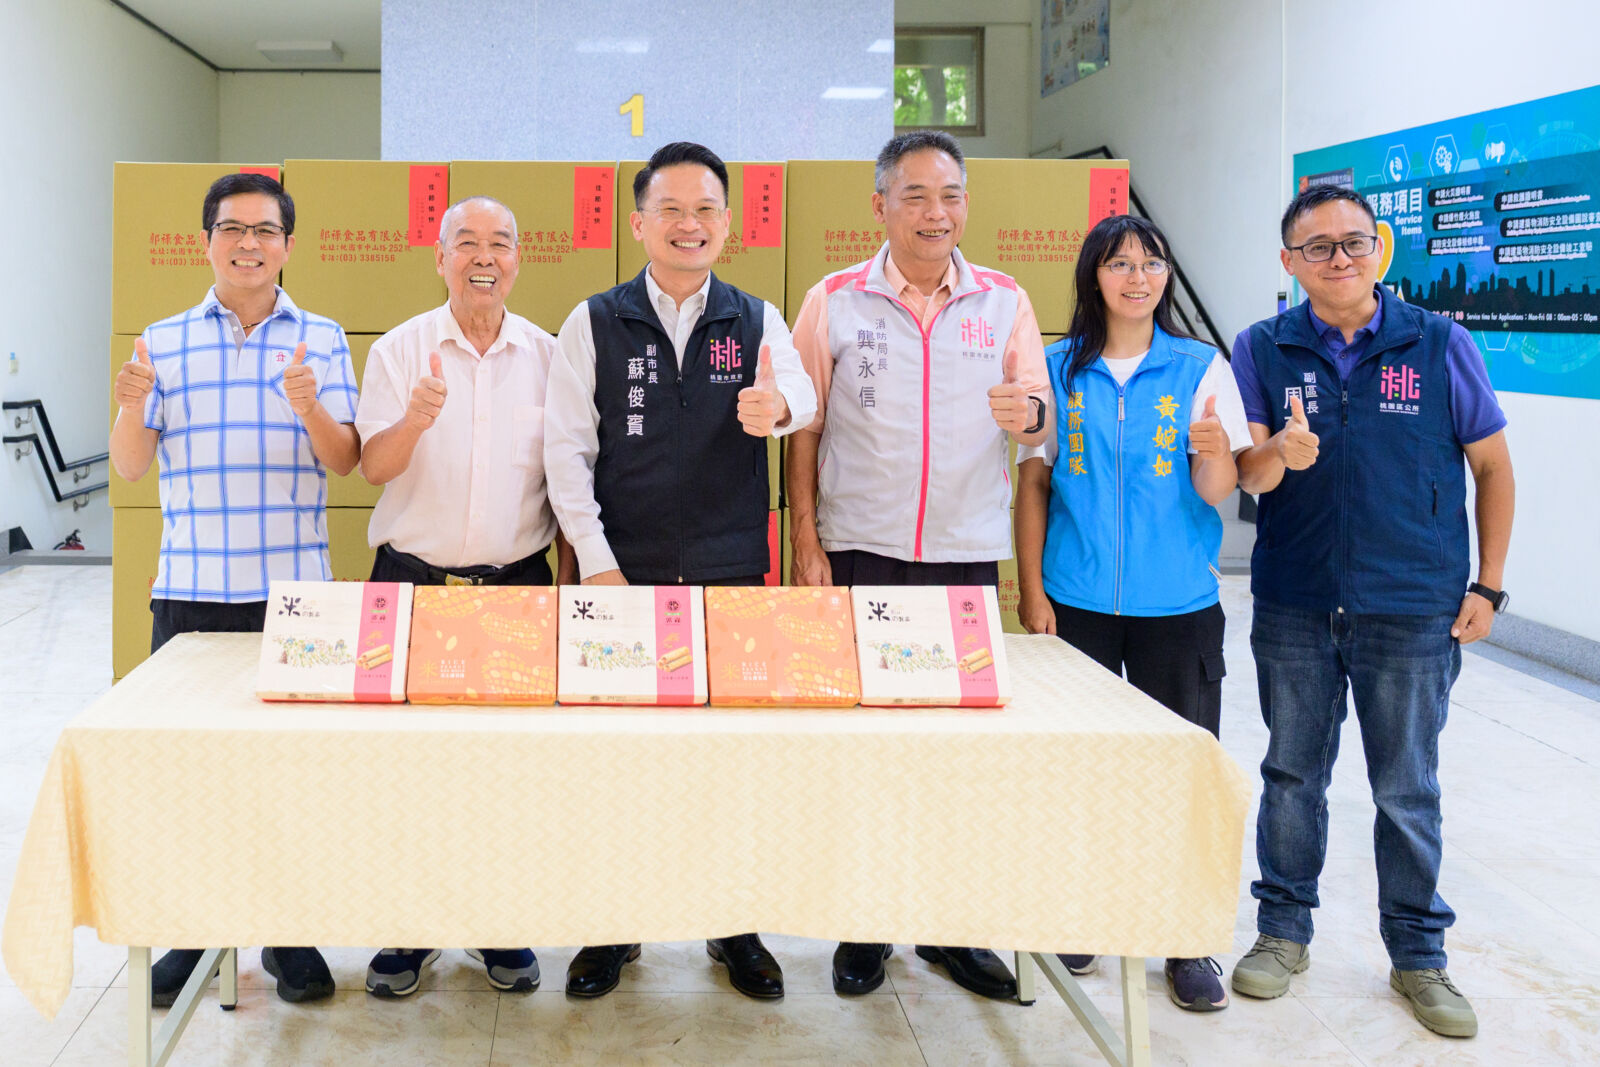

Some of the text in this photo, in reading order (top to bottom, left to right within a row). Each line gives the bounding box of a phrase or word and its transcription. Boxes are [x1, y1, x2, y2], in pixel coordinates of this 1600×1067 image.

[619, 93, 644, 137] 1
[1366, 187, 1422, 217] 服務項目
[1395, 215, 1422, 226] Service
[1401, 226, 1422, 236] Items
[360, 254, 395, 262] 3385156
[1038, 254, 1074, 262] 3385156
[876, 318, 888, 371] 消防局長
[646, 344, 658, 384] 副市長
[857, 329, 875, 408] 龔永信
[627, 357, 645, 436] 蘇俊賓
[1304, 371, 1319, 414] 副區長
[1066, 392, 1088, 476] 服務團隊
[1152, 395, 1180, 477] 黃婉如
[278, 595, 301, 616] 米
[572, 600, 594, 620] 米
[868, 601, 890, 621] 米
